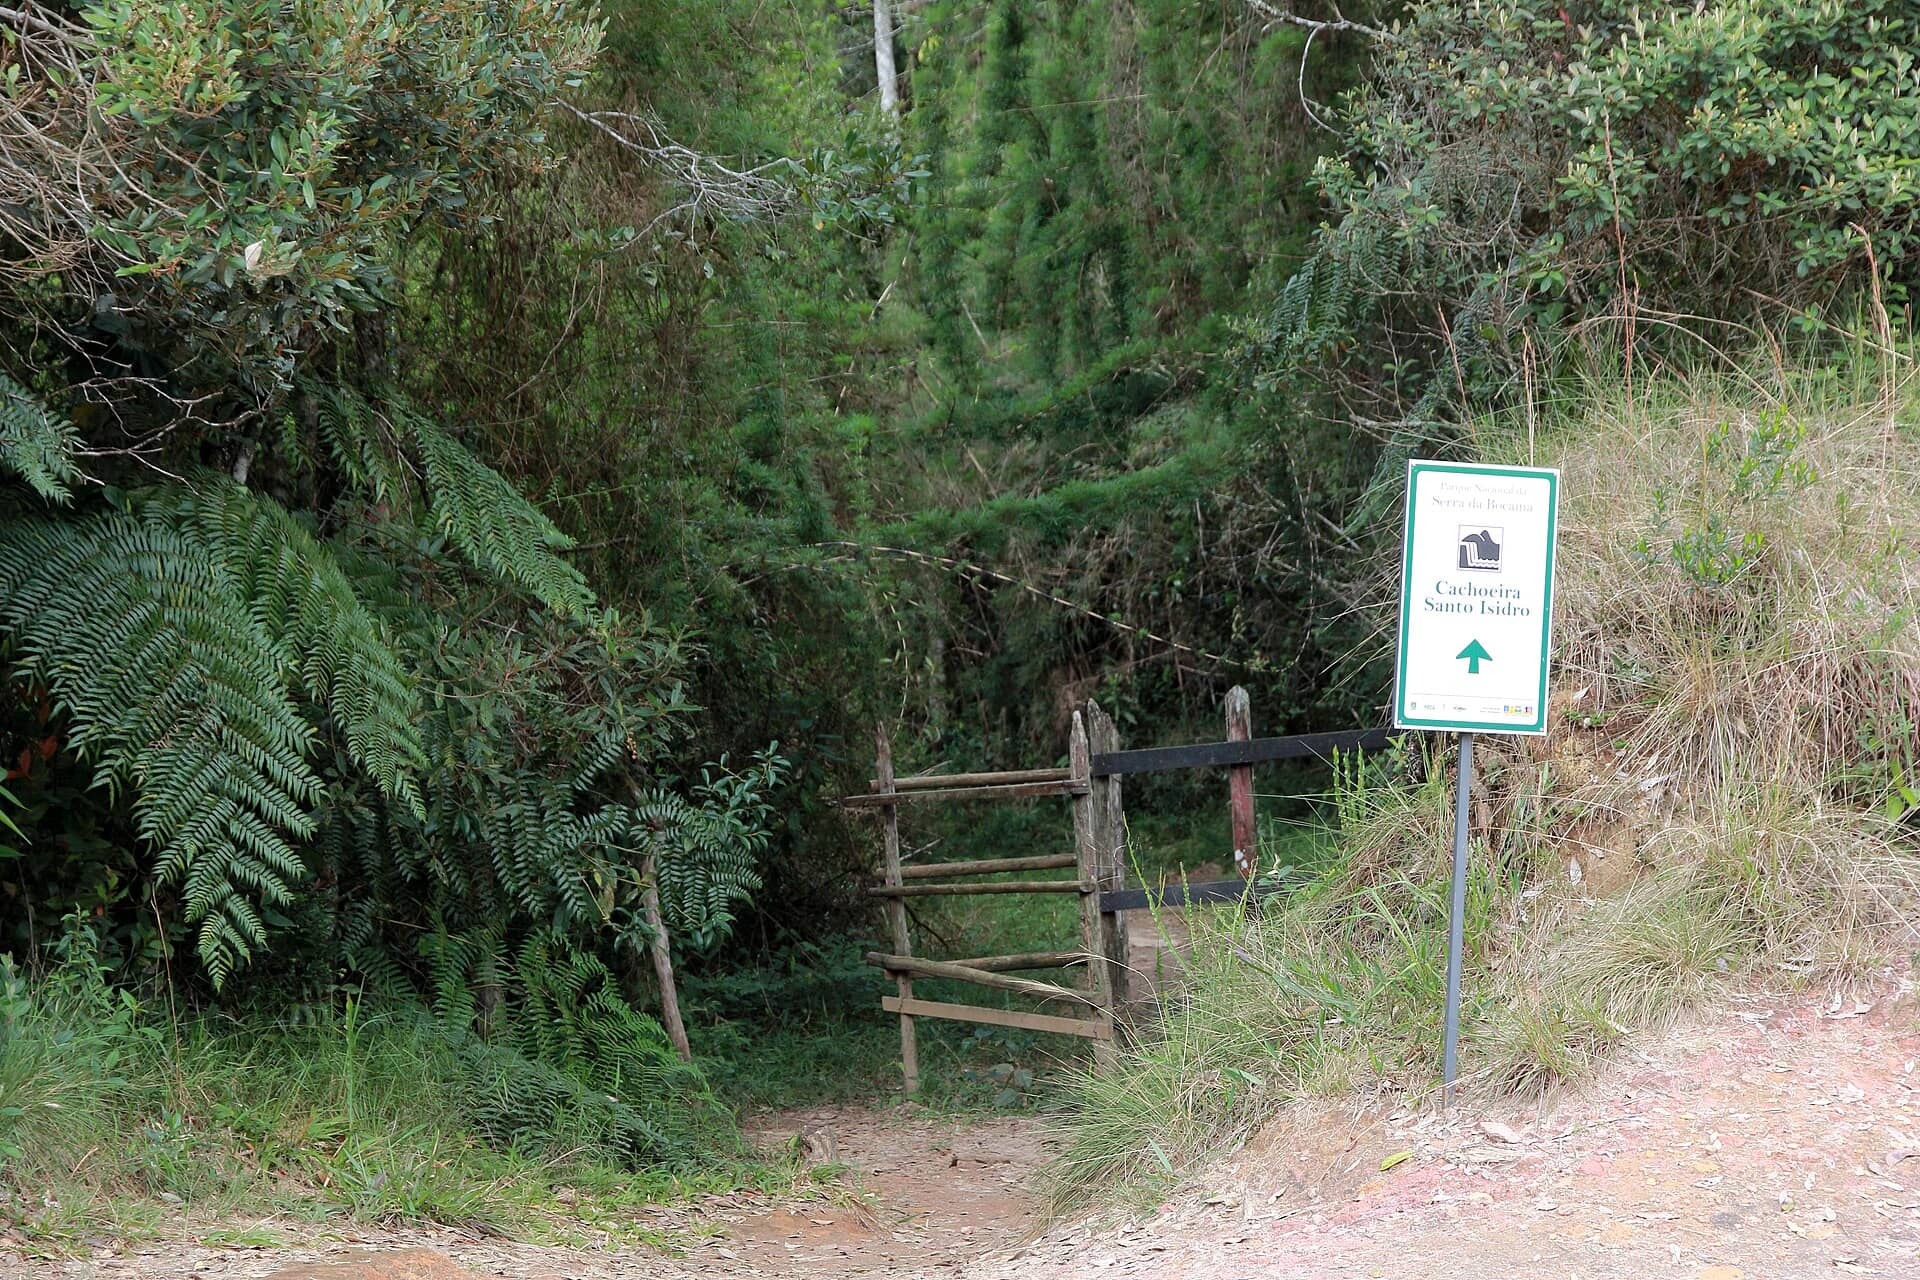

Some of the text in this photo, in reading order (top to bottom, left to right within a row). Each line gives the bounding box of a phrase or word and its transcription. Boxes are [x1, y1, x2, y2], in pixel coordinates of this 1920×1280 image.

[1432, 495, 1465, 509] Serra
[1468, 497, 1482, 510] da
[1435, 580, 1521, 600] Cachoeira
[1424, 597, 1530, 617] Santo Isidro
